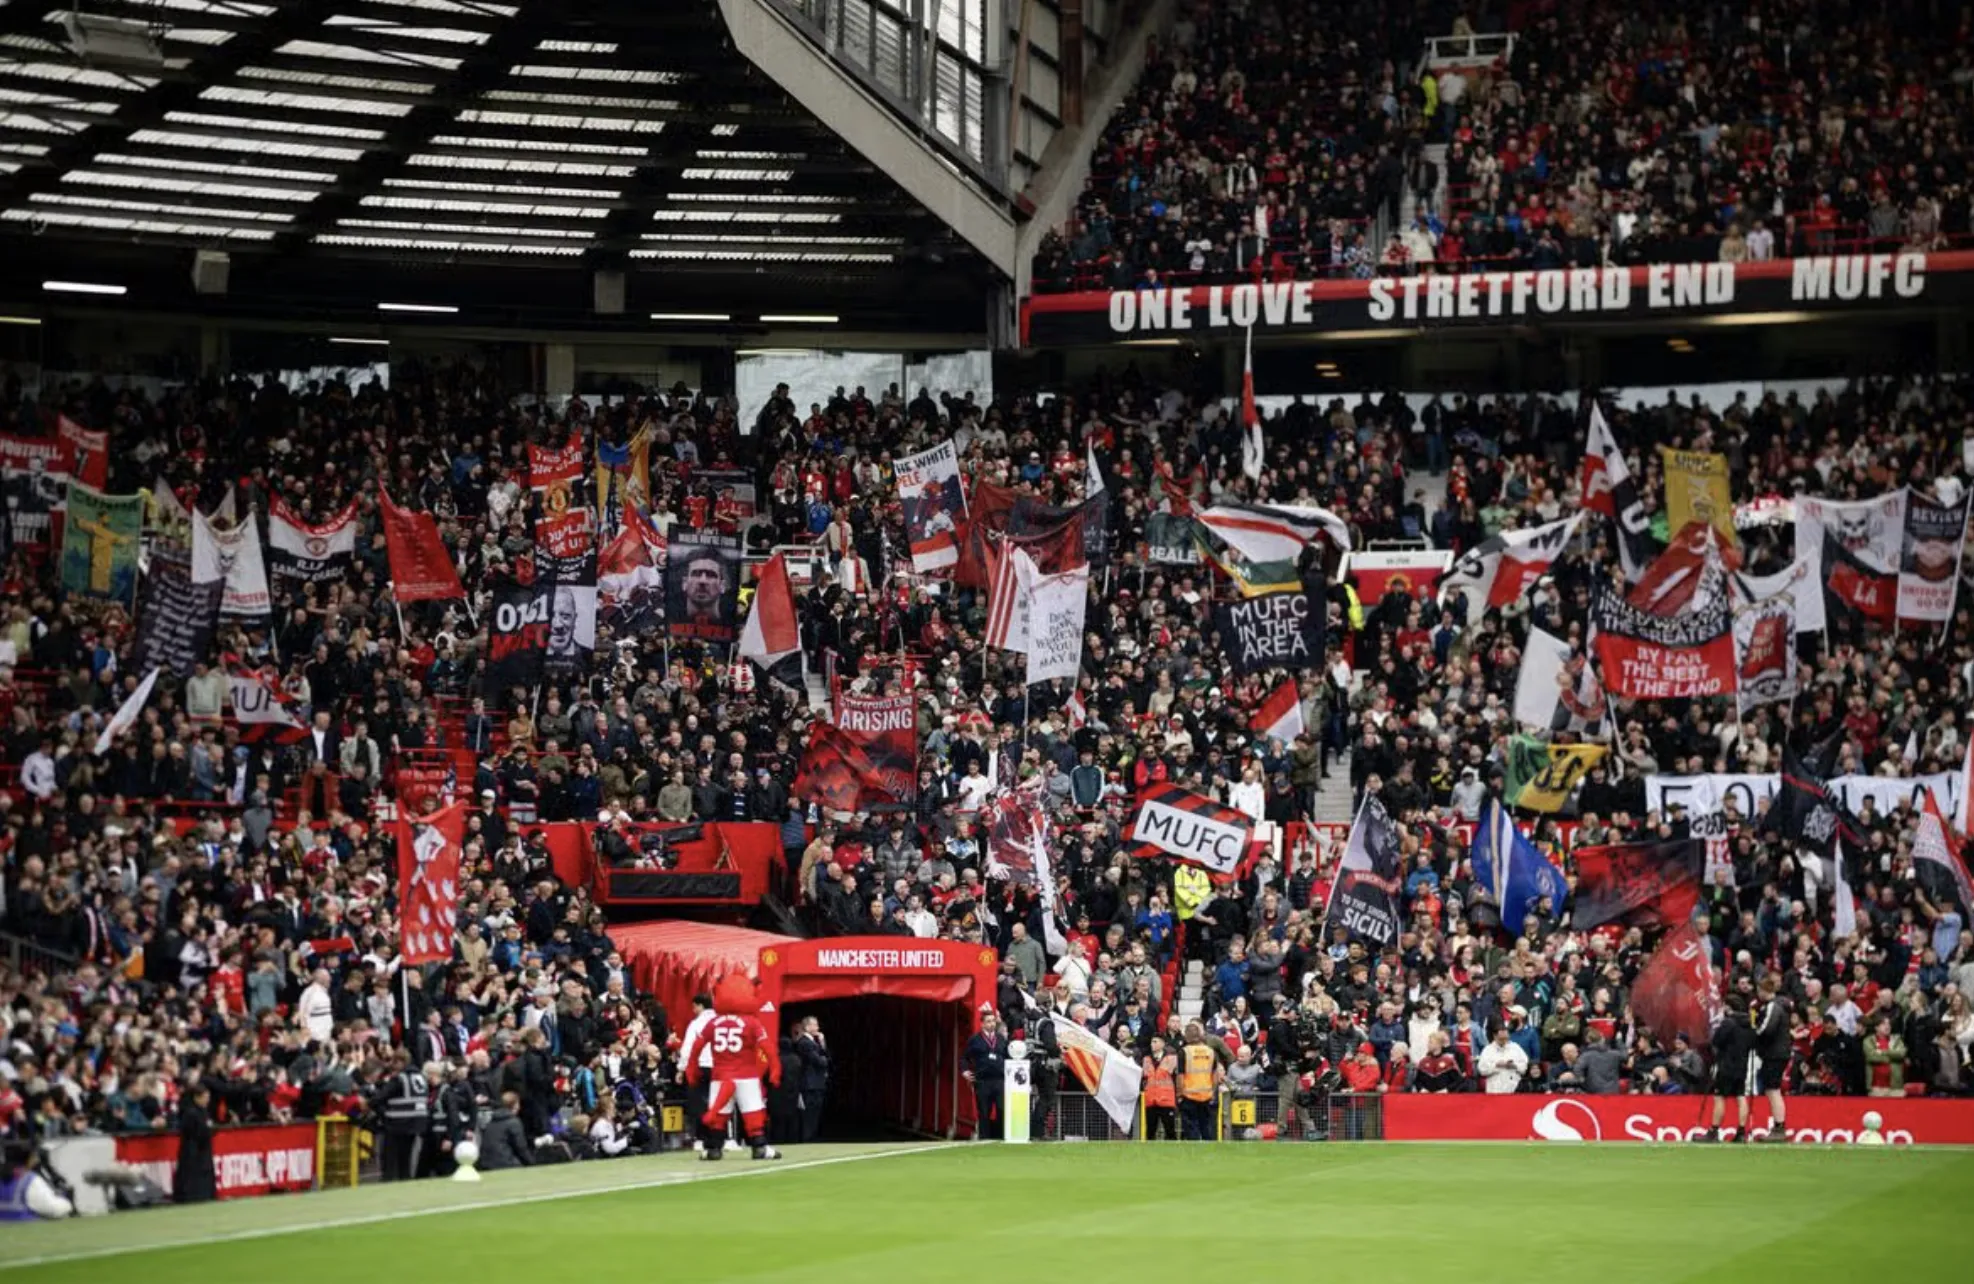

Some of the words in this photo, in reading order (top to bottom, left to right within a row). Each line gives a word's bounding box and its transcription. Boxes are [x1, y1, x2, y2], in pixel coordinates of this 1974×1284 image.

[1791, 253, 1926, 300] MUFC
[1368, 266, 1629, 320] STRETFORD
[1648, 262, 1735, 308] END
[1109, 287, 1192, 332] ONE
[1209, 282, 1313, 327] LOVE
[914, 445, 951, 468] WHITE
[1149, 546, 1199, 564] SEALE
[1230, 594, 1309, 628] MUFC
[1238, 622, 1257, 644] IN
[1261, 617, 1301, 638] THE
[1603, 612, 1635, 635] THE
[1242, 630, 1309, 663] AREA
[1637, 645, 1660, 662] BY
[1622, 659, 1659, 679] THE
[1661, 662, 1710, 682] BEST
[1633, 678, 1670, 697] THE
[1673, 677, 1721, 698] LAND
[839, 707, 913, 732] ARISING
[1340, 907, 1393, 944] SICILY
[818, 950, 899, 968] MANCHESTER
[901, 950, 944, 968] UNITED
[714, 1027, 743, 1053] 55
[668, 1115, 676, 1129] 7
[1240, 1109, 1248, 1123] 6
